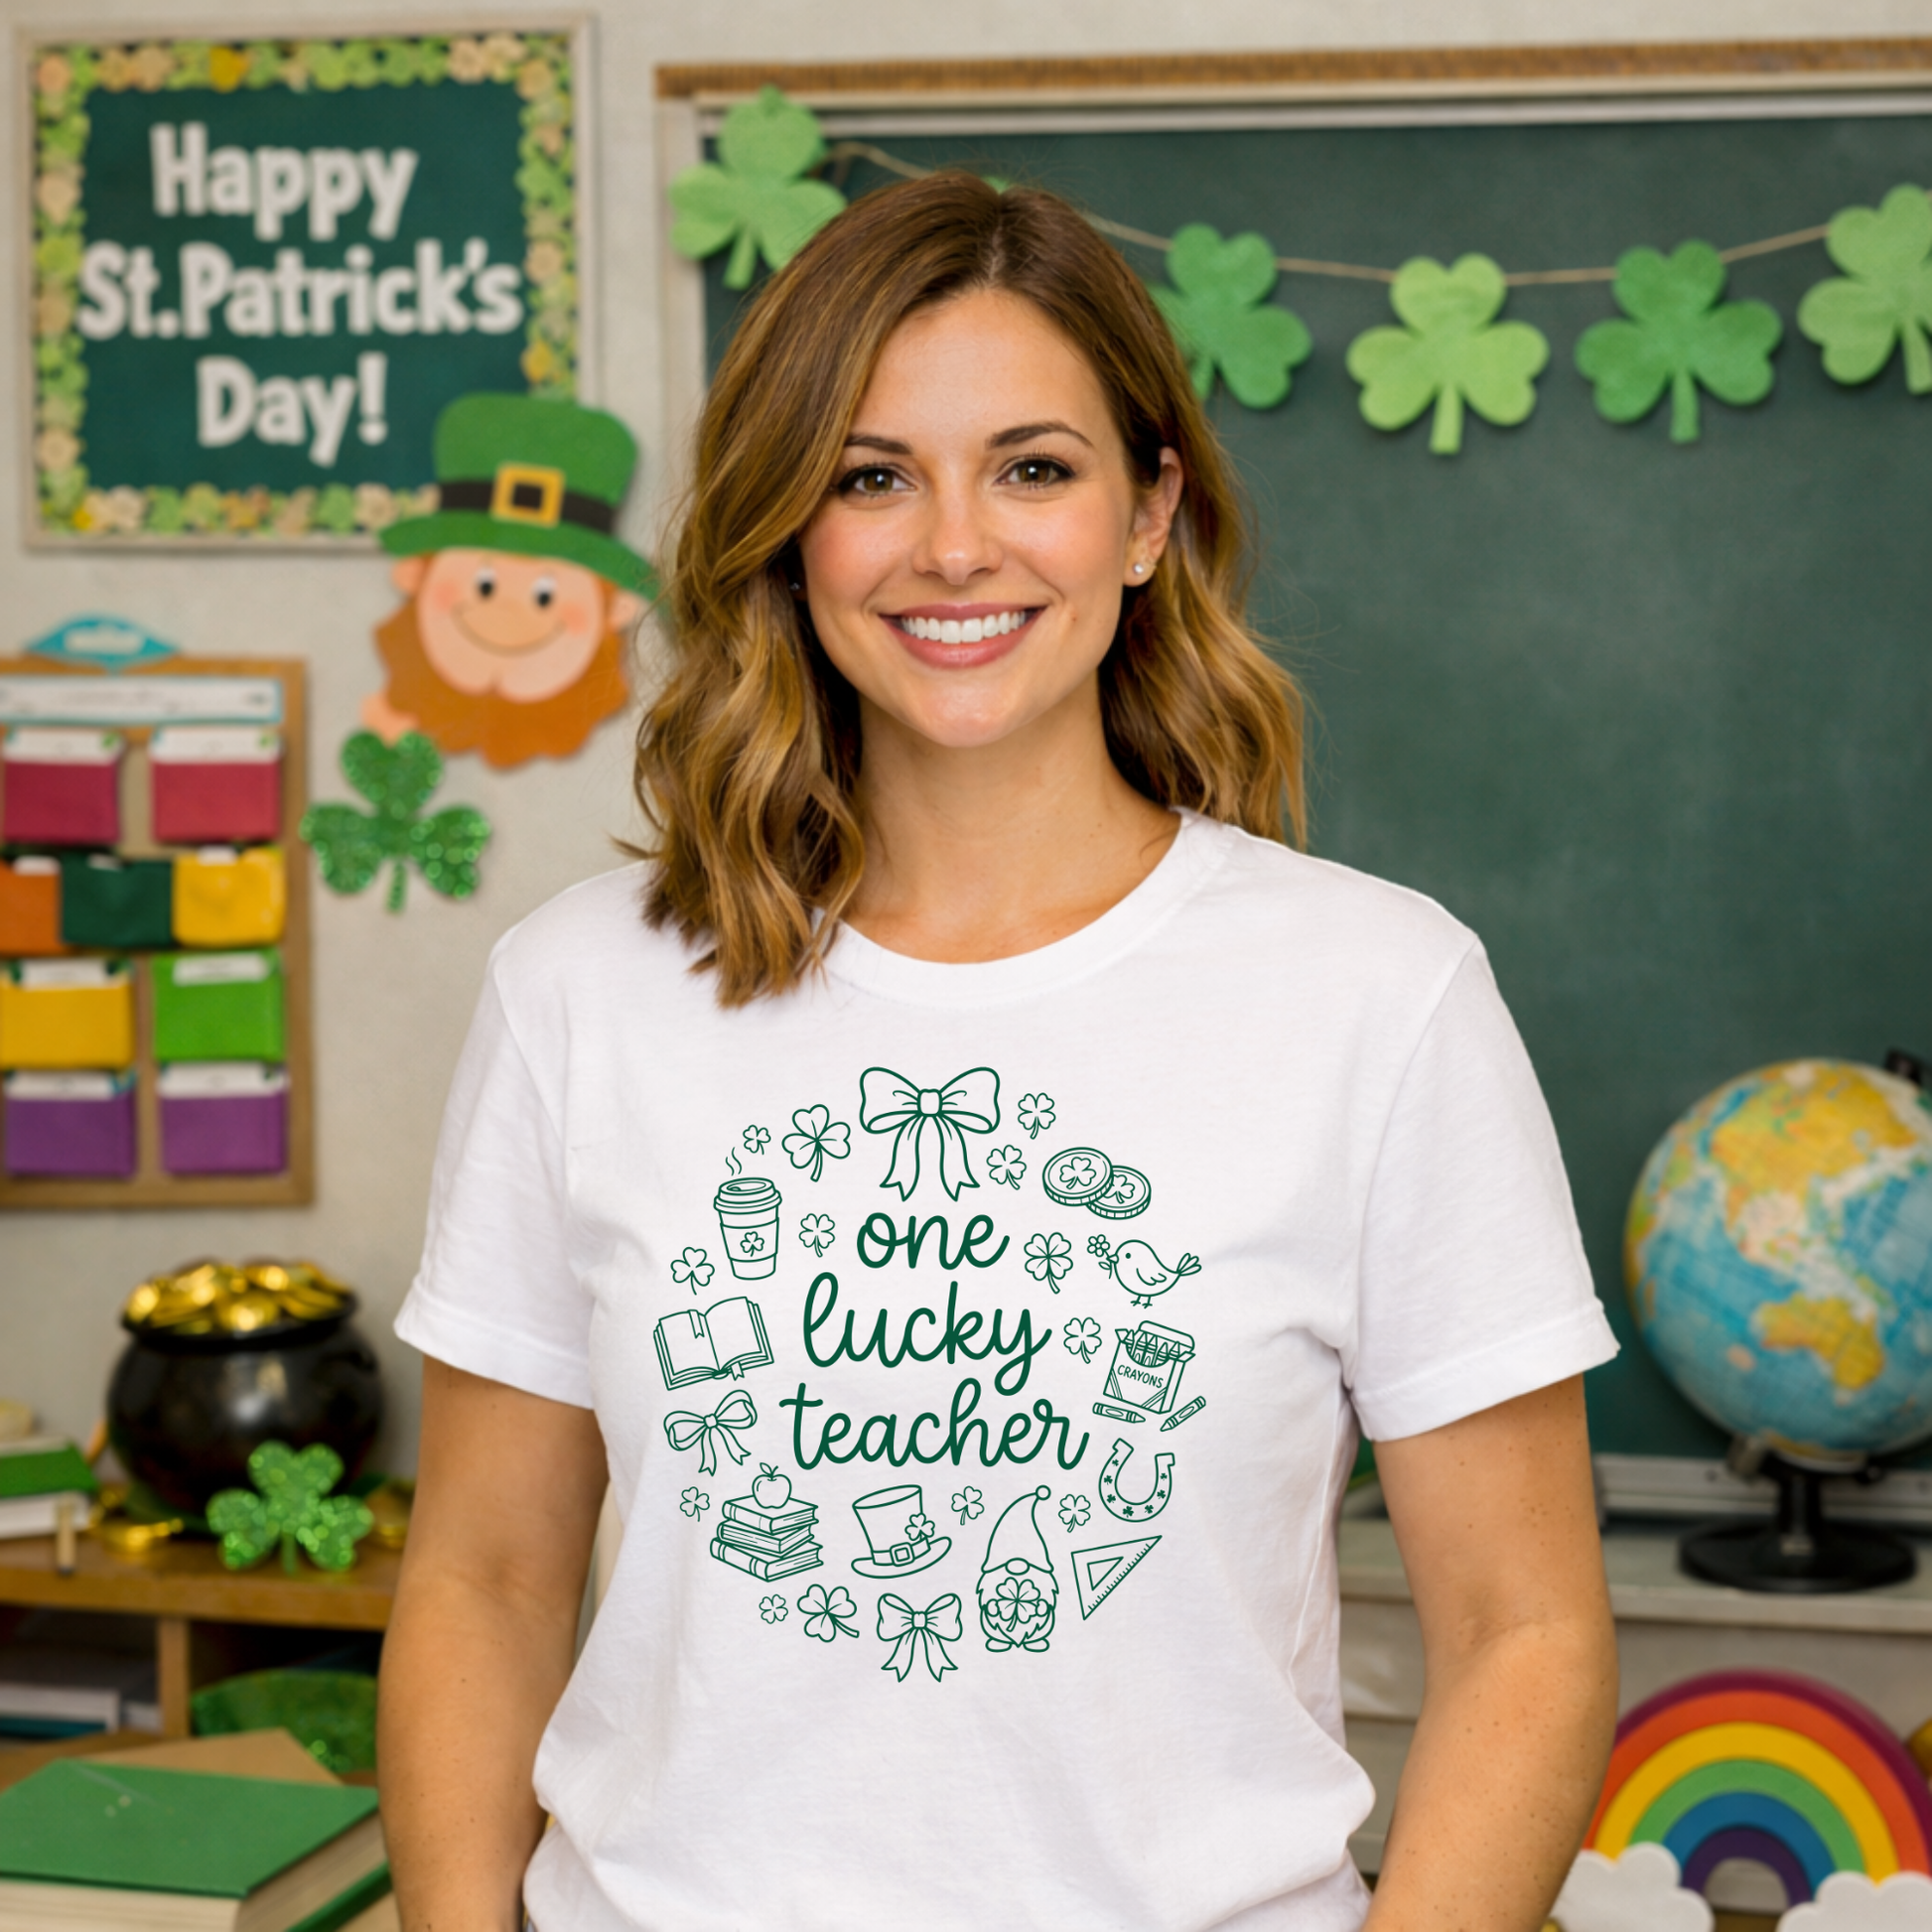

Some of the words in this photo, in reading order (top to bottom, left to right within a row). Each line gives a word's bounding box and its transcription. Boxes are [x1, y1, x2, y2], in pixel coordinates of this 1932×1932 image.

[151, 121, 417, 239] Happy
[196, 351, 388, 467] Day!
[857, 1211, 1010, 1270] one
[802, 1272, 1052, 1397] lucky
[1117, 1364, 1164, 1389] CRAYONS
[778, 1378, 1089, 1470] teacher
